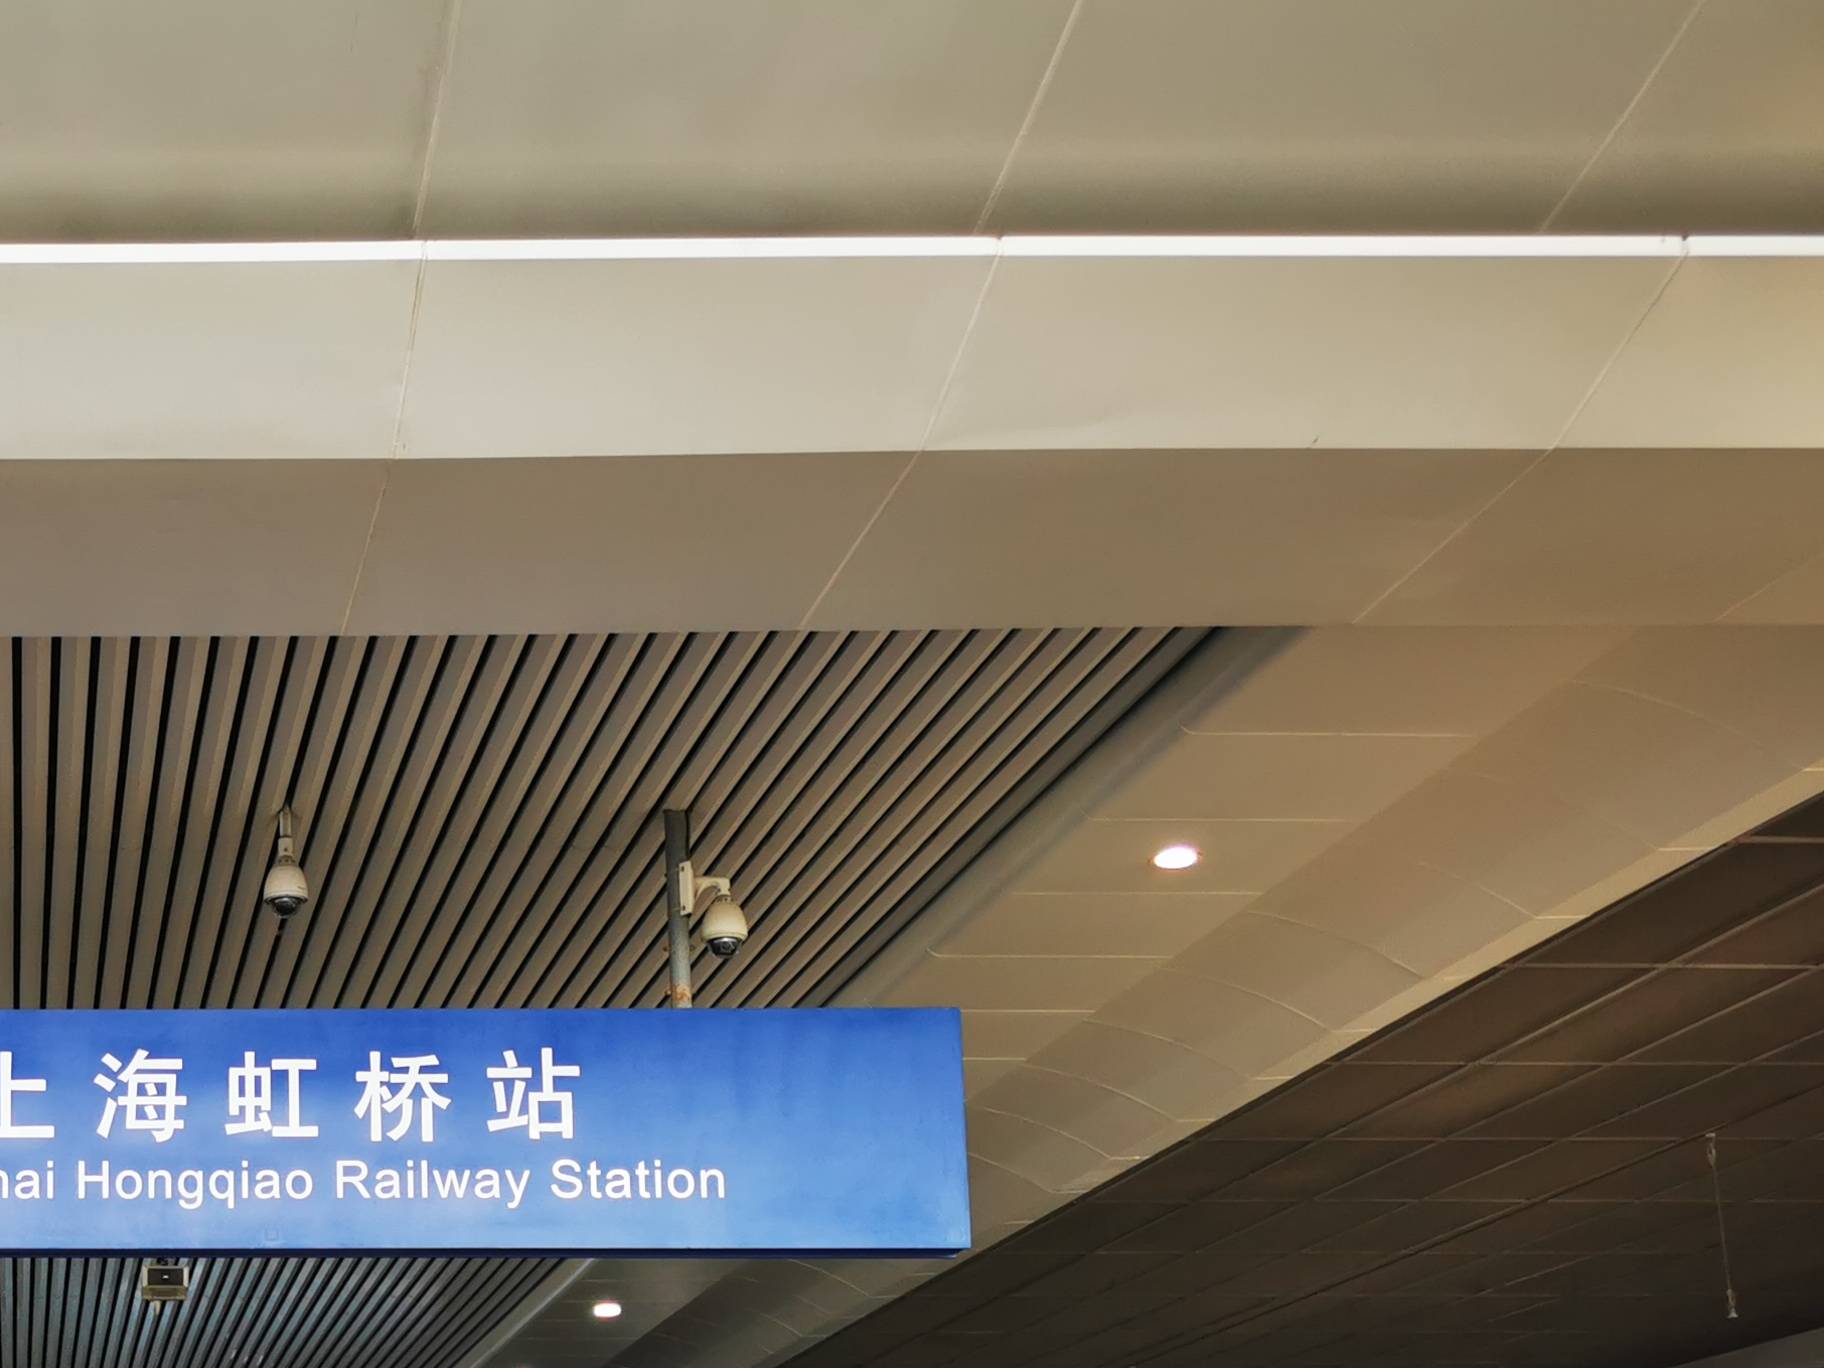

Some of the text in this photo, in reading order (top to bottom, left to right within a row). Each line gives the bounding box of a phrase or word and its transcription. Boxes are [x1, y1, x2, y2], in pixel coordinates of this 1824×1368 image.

[78, 1160, 314, 1213] Hongqiao
[336, 1159, 533, 1213] Railway
[551, 1159, 728, 1202] Station
